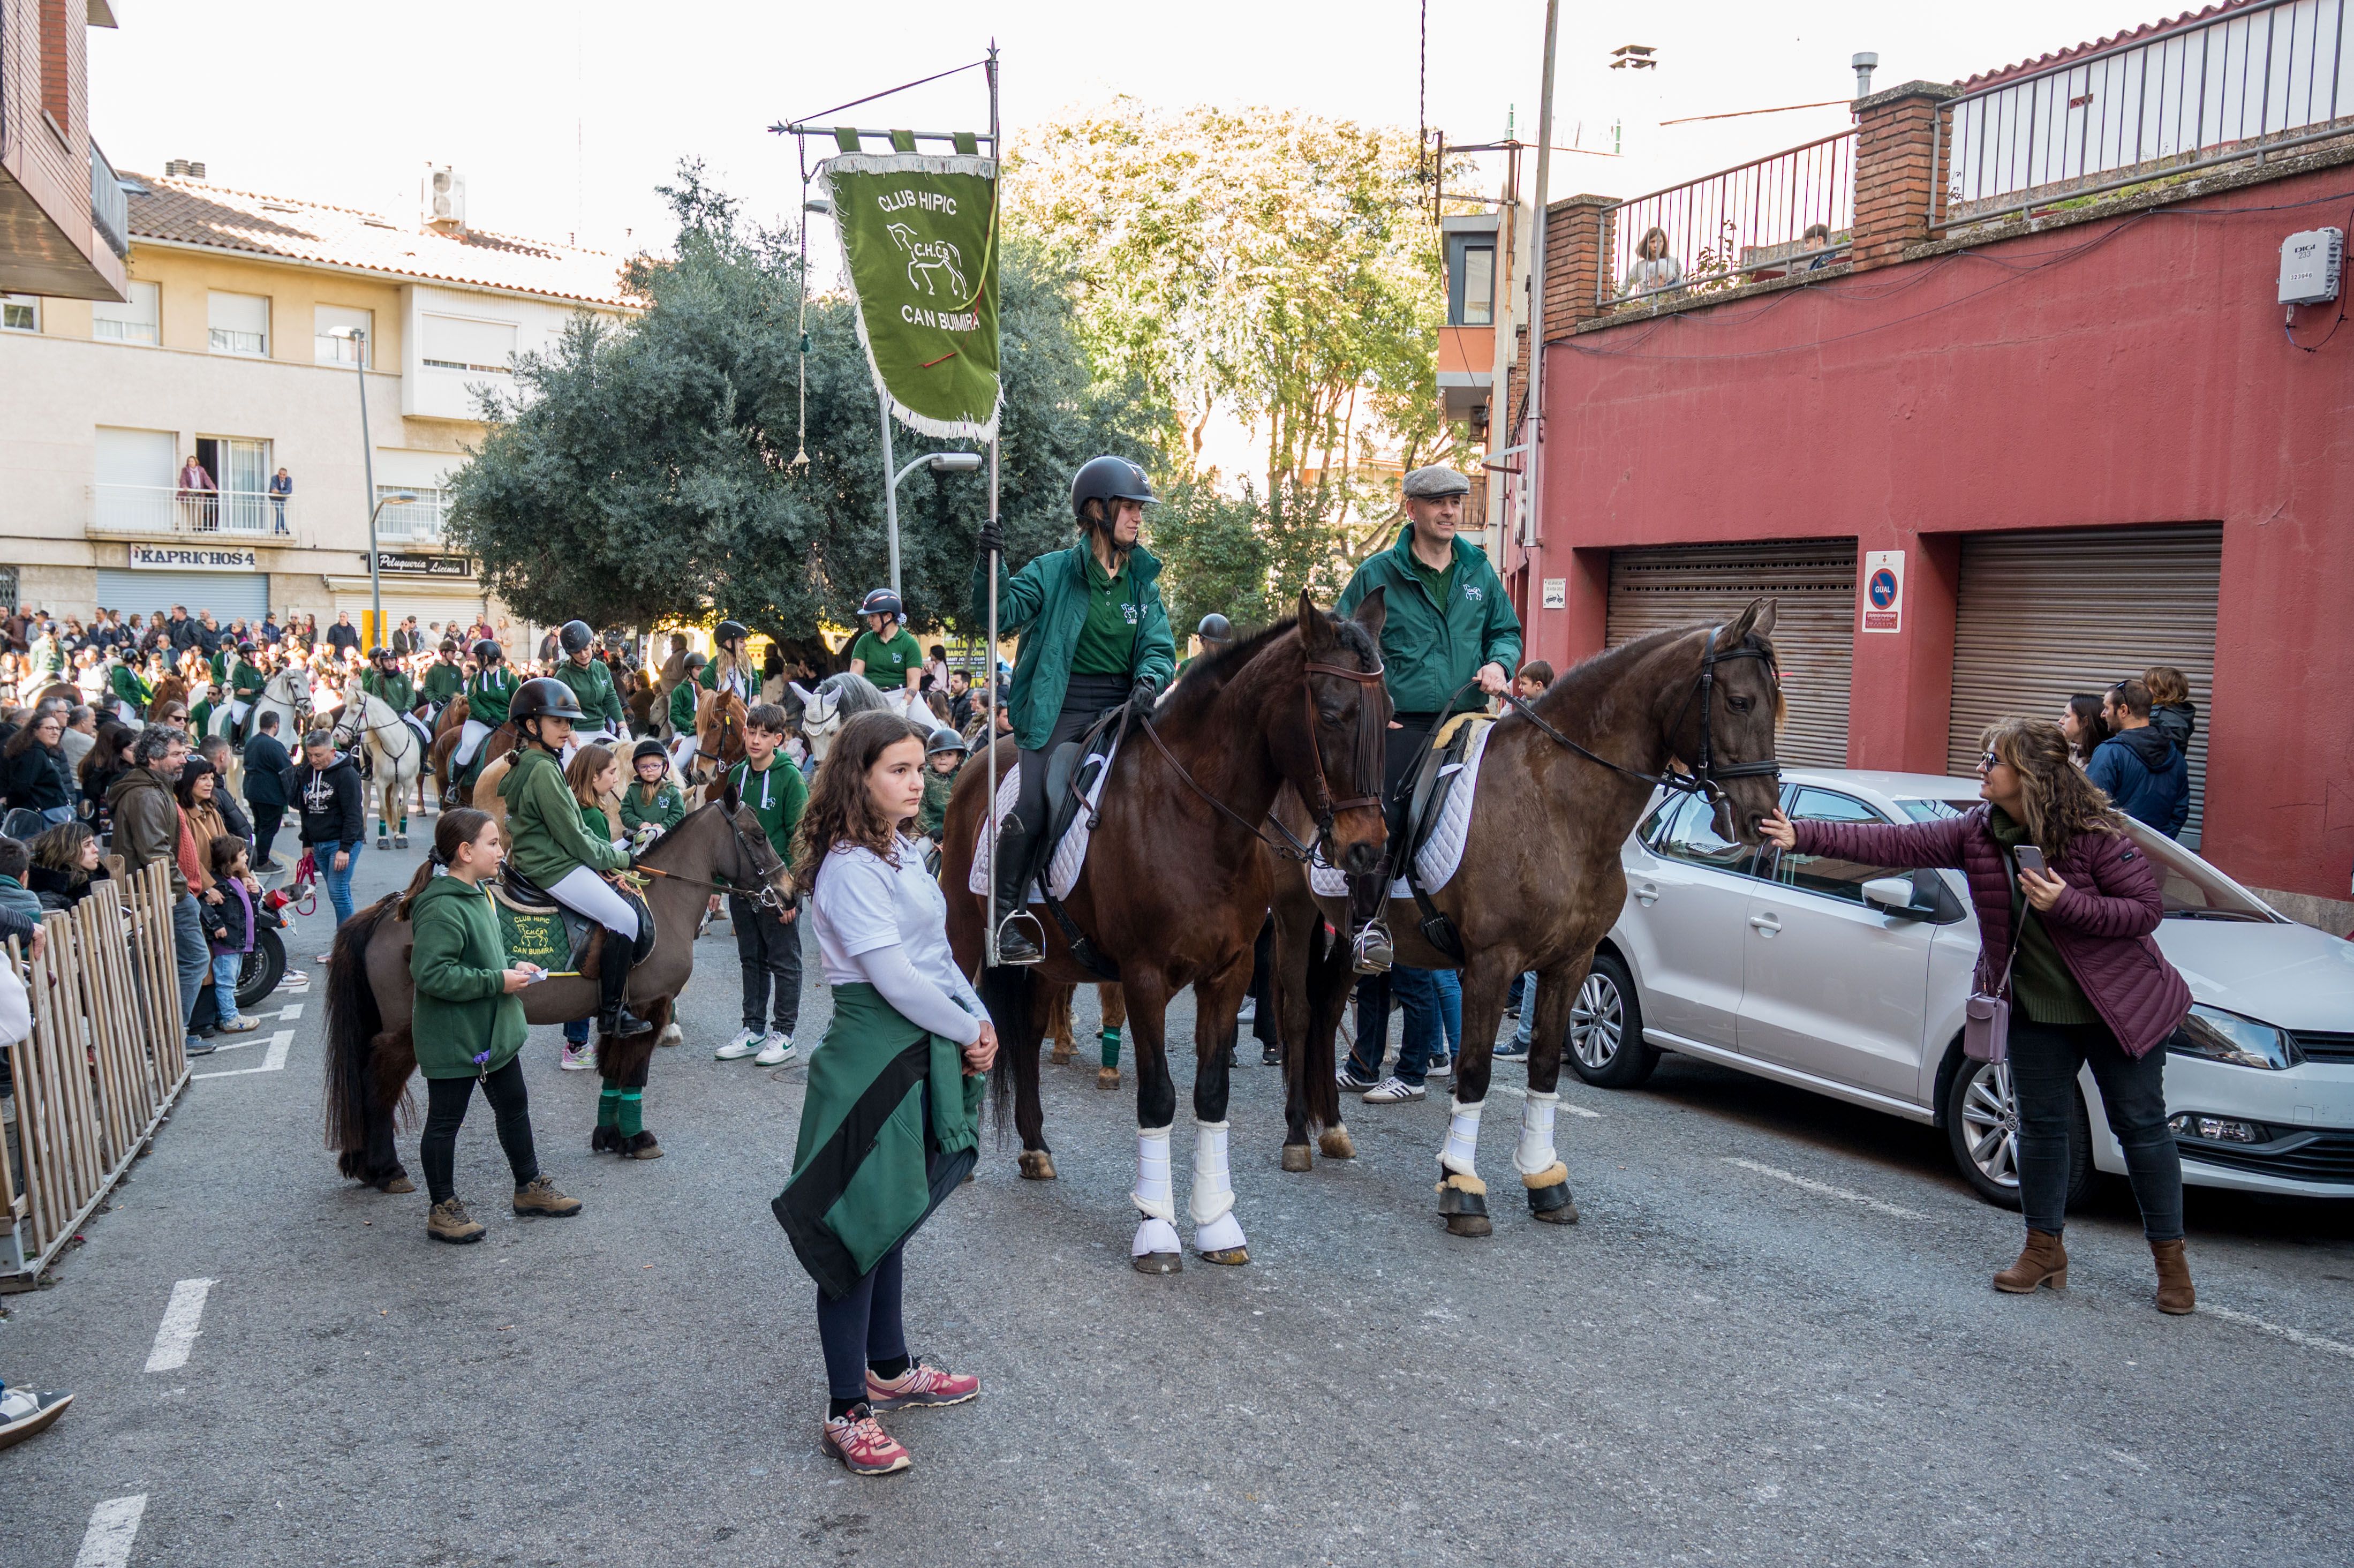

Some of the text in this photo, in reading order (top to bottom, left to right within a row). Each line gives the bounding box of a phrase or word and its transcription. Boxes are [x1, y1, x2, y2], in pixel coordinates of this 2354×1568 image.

[878, 190, 956, 215] CLUB HIPIC
[2295, 244, 2315, 253] DIGI
[2298, 250, 2311, 259] 233
[901, 305, 980, 331] CAN BUIMIRA
[140, 550, 243, 565] KAPRICHOS
[429, 562, 461, 573] Licinia
[533, 916, 550, 924] HIPIC
[512, 945, 554, 955] CAN BUIMIRA
